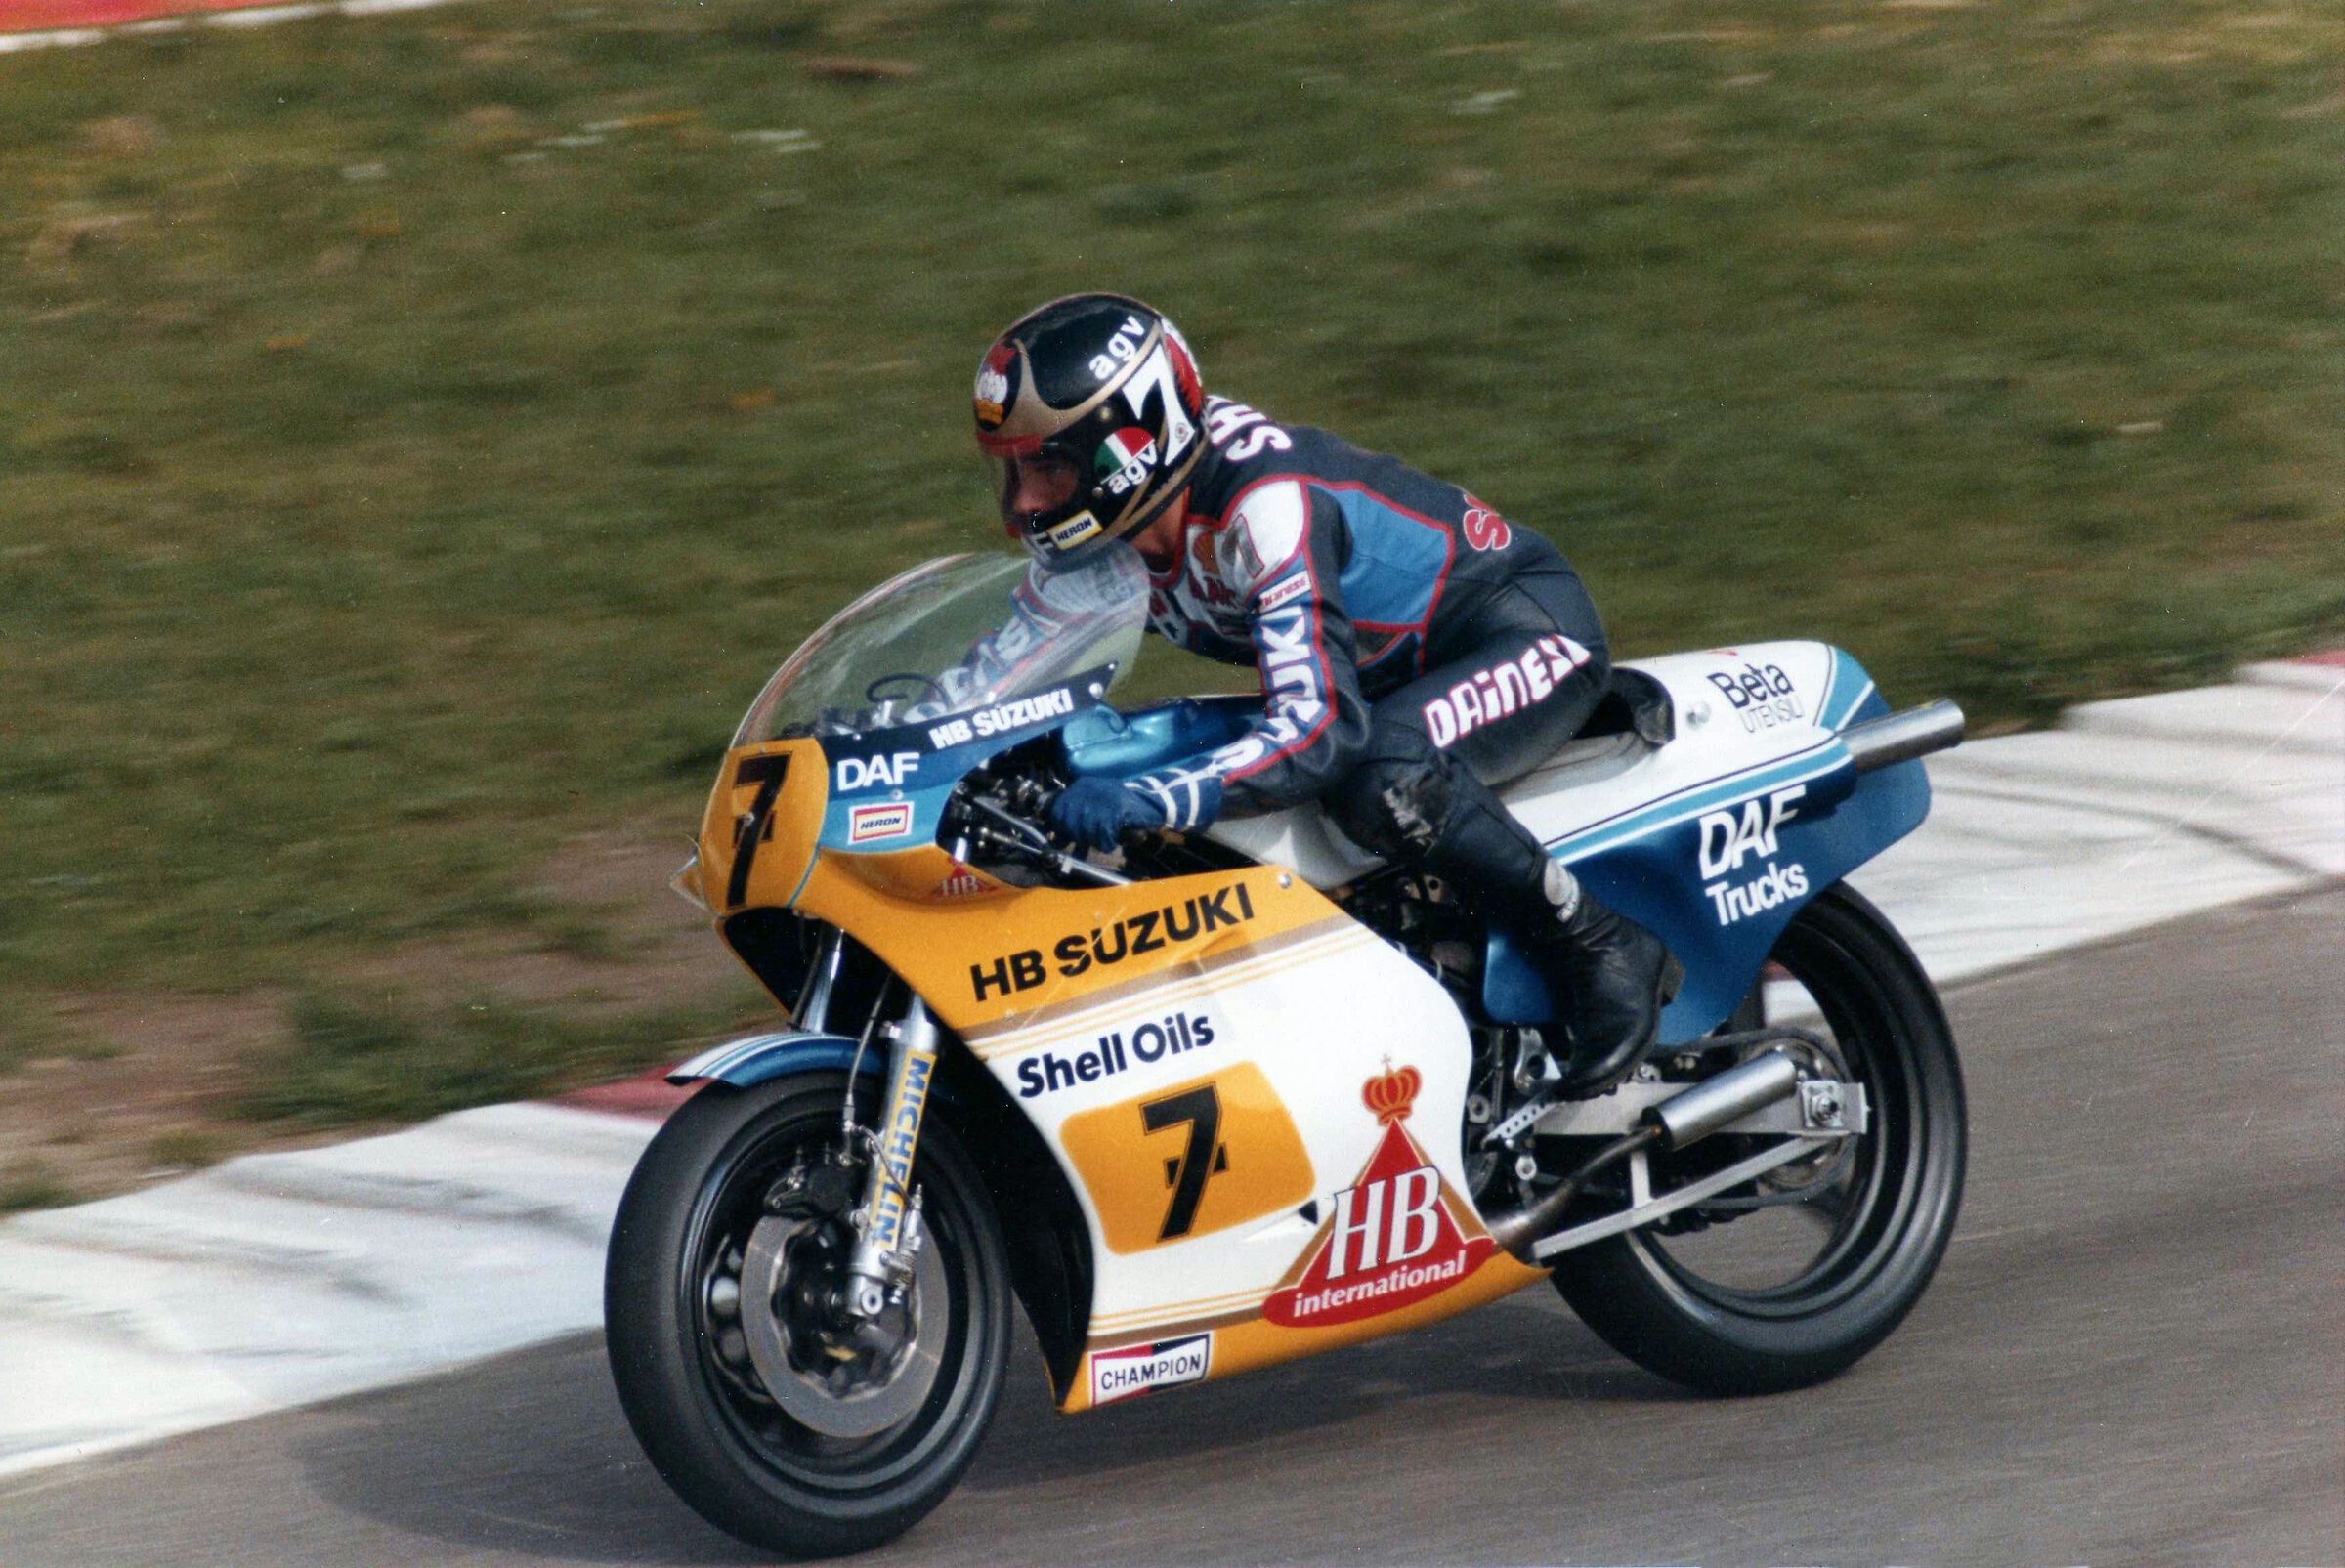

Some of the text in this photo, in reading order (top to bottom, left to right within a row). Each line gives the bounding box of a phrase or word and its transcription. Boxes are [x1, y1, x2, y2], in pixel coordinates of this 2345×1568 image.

[1088, 316, 1145, 380] agv
[1122, 343, 1196, 467] 7
[1108, 445, 1159, 495] agv
[1055, 517, 1093, 542] HERON
[928, 687, 1075, 750] HB SUZUKI
[1707, 663, 1795, 709] Beta
[836, 751, 920, 791] DAF
[727, 750, 793, 909] 7
[859, 815, 903, 830] HERON
[1698, 784, 1807, 880] DAF
[1704, 861, 1809, 927] Trucks
[969, 881, 1256, 1002] HB SUZUKI
[1017, 1011, 1215, 1098] Shell Oils
[870, 1056, 931, 1244] MICHELIN
[1138, 1081, 1230, 1244] 7
[1324, 1164, 1443, 1280] HB
[1292, 1249, 1466, 1318] international
[1100, 1352, 1204, 1391] CHAMPION
